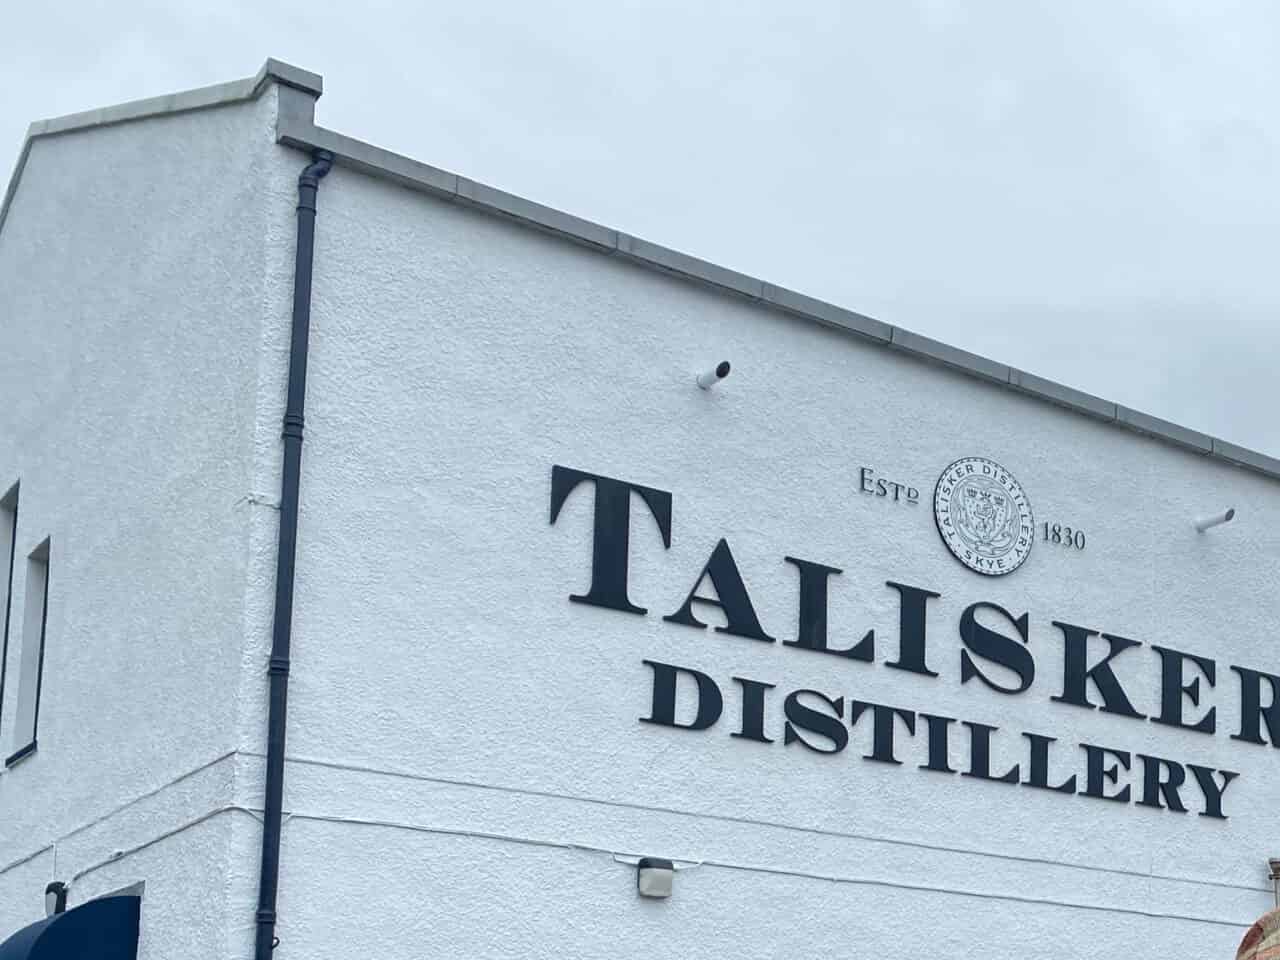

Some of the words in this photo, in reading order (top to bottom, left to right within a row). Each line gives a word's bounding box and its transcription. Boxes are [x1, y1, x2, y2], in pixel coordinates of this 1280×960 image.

[941, 464, 976, 539] TALISKER
[982, 465, 1030, 559] DISTILLERY
[1042, 521, 1086, 551] 1830
[964, 549, 1005, 570] SKYE
[639, 659, 1241, 820] DISTILLERY
